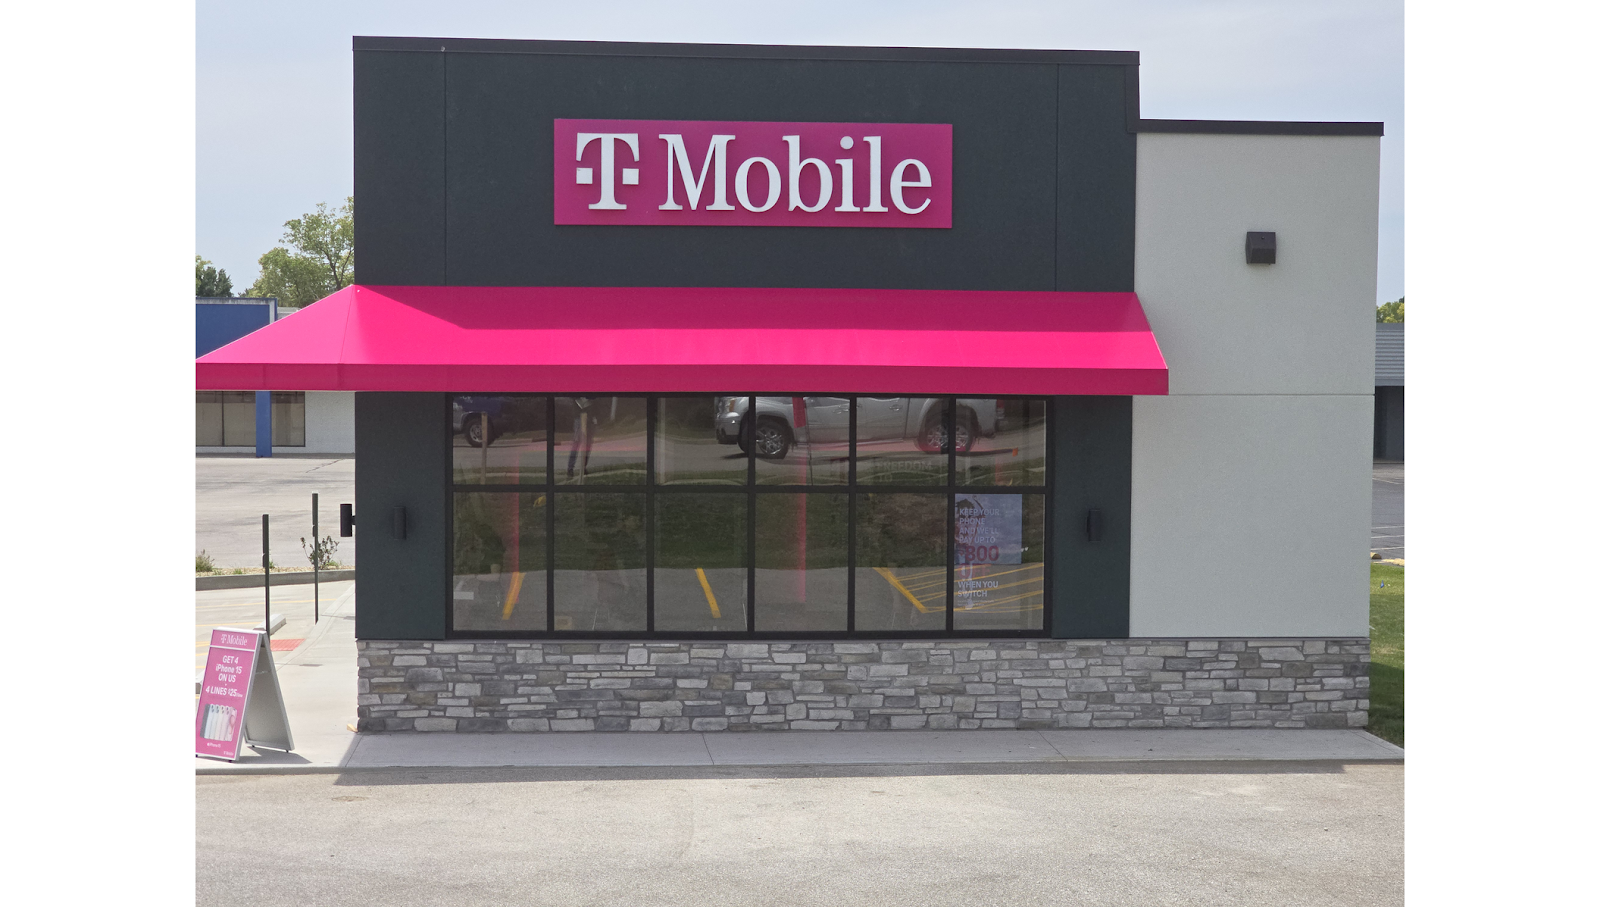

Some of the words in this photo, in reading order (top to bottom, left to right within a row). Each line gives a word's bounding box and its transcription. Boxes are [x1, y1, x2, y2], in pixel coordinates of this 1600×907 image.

[575, 132, 641, 211] T
[658, 133, 933, 215] Mobile
[959, 508, 979, 516] KEEP
[979, 508, 1000, 516] YOUR
[959, 517, 986, 525] PHONE
[958, 527, 976, 535] AND
[977, 527, 999, 535] WE'LL
[958, 536, 973, 544] PAY
[974, 536, 985, 544] UP
[985, 536, 996, 544] TO
[957, 563, 991, 579] OFF
[957, 580, 982, 588] WHEN
[982, 580, 999, 588] YOU
[957, 590, 988, 598] SWITCH
[227, 635, 248, 646] Mobile
[223, 655, 234, 664] GET
[216, 664, 235, 673] iPhone
[236, 666, 243, 674] 15
[218, 673, 228, 681] ON
[228, 675, 237, 683] US
[205, 686, 210, 694] 4
[210, 686, 228, 696] LINES
